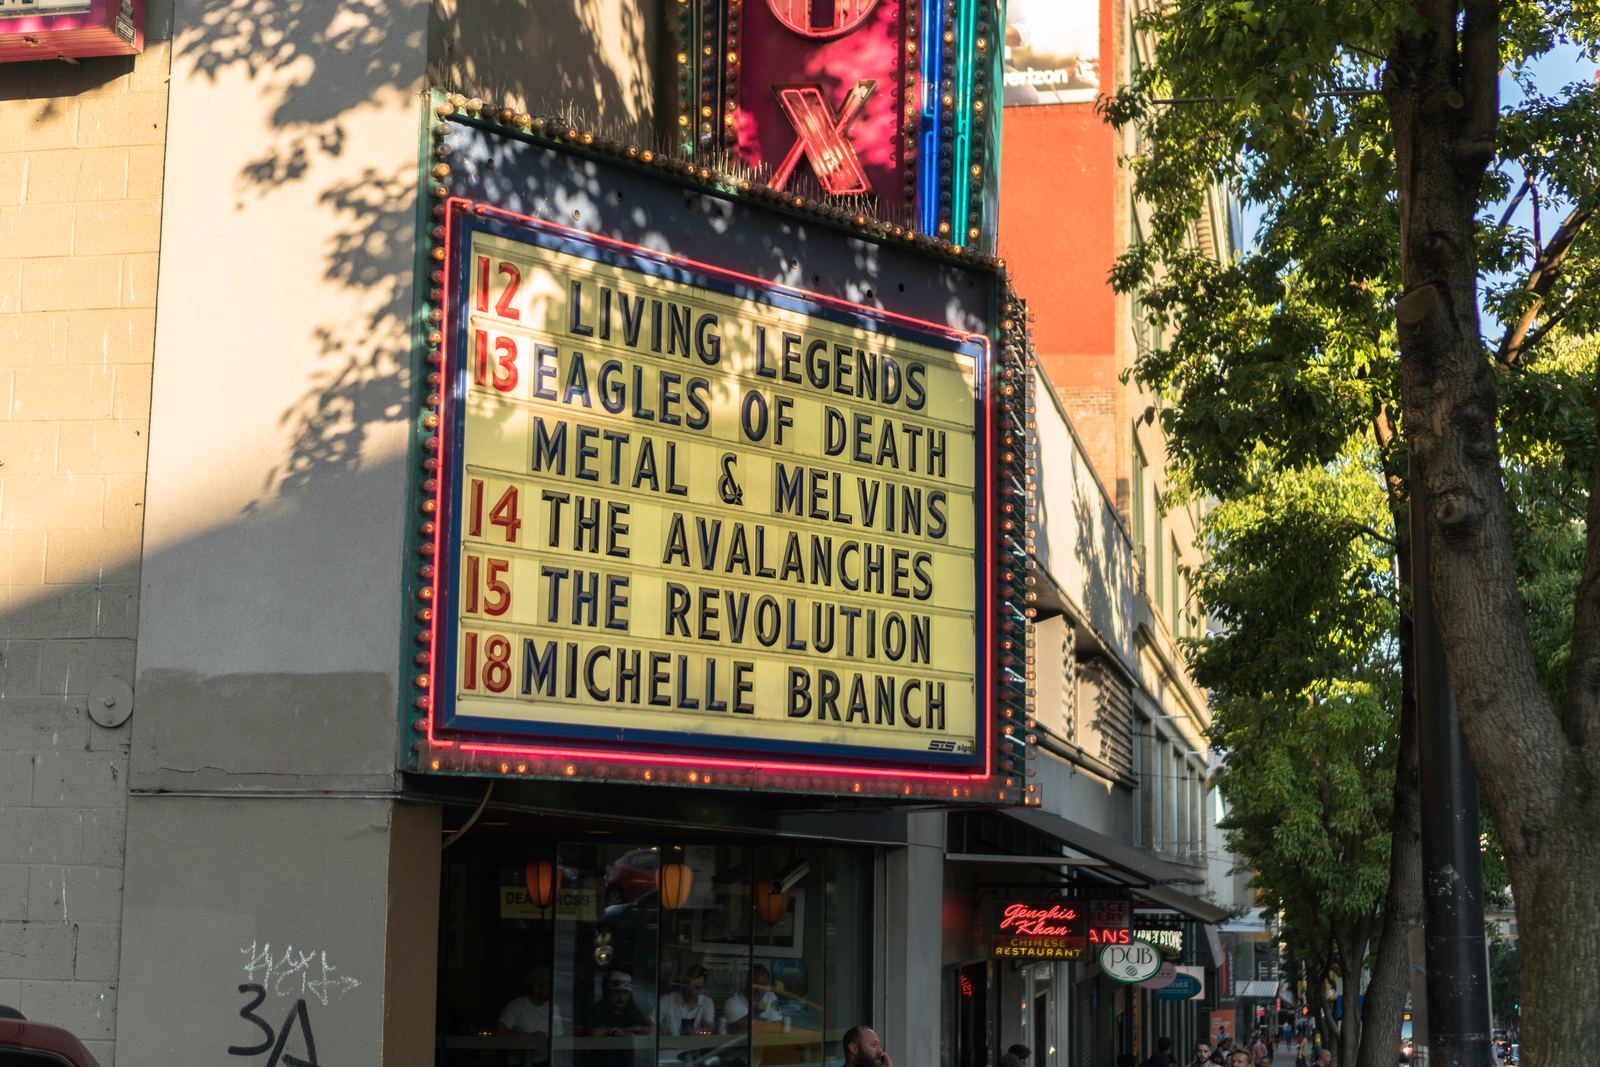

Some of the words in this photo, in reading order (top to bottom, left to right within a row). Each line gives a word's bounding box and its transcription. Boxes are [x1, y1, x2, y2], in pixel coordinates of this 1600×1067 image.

[476, 255, 521, 320] 12
[568, 280, 720, 366] LIVING
[756, 325, 926, 410] LEGENDS
[473, 329, 518, 392] 13
[533, 343, 711, 430] EAGLES
[741, 389, 794, 445] OF
[824, 406, 946, 478] DEATH
[531, 416, 688, 496] METAL
[718, 452, 743, 506] &
[775, 462, 947, 539] MELVINS
[468, 480, 522, 542] 14
[542, 490, 631, 557] THE
[663, 512, 932, 600] AVALANCHES
[465, 556, 510, 616] 15
[541, 565, 630, 630] THE
[666, 582, 931, 664] REVOLUTION
[464, 632, 512, 693] 18
[522, 638, 755, 713] MICHELLE
[788, 667, 945, 730] BRANCH
[995, 947, 1082, 957] RESTAURANT
[1000, 903, 1076, 929] Genghis
[1010, 938, 1066, 947] CHINESE
[1014, 920, 1069, 935] Khan
[1089, 928, 1131, 943] ANS
